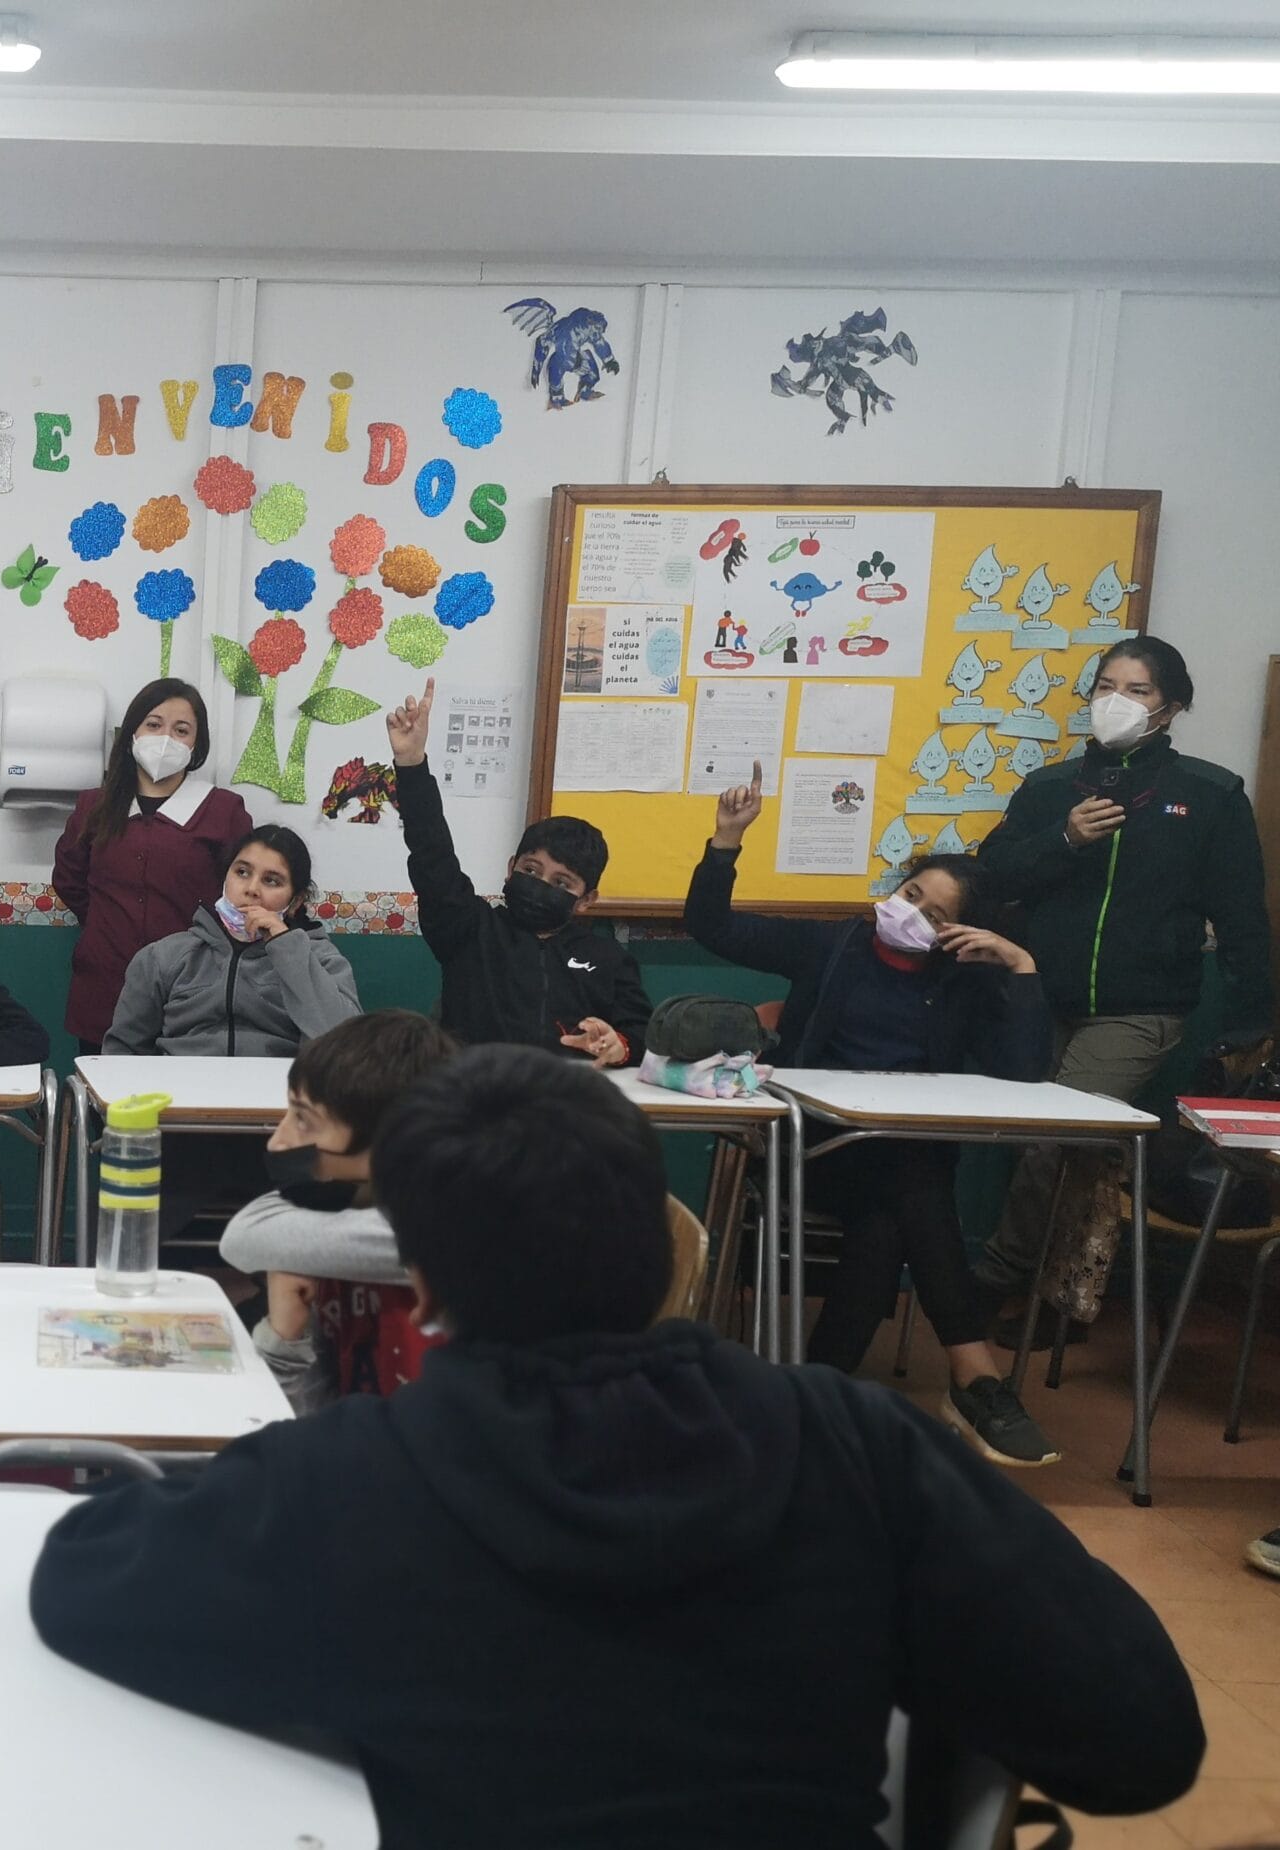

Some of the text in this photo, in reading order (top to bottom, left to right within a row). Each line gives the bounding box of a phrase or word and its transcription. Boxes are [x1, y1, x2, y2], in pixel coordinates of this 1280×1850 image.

[618, 642, 640, 651] agua
[606, 676, 638, 684] planeta
[1165, 805, 1186, 815] SAG
